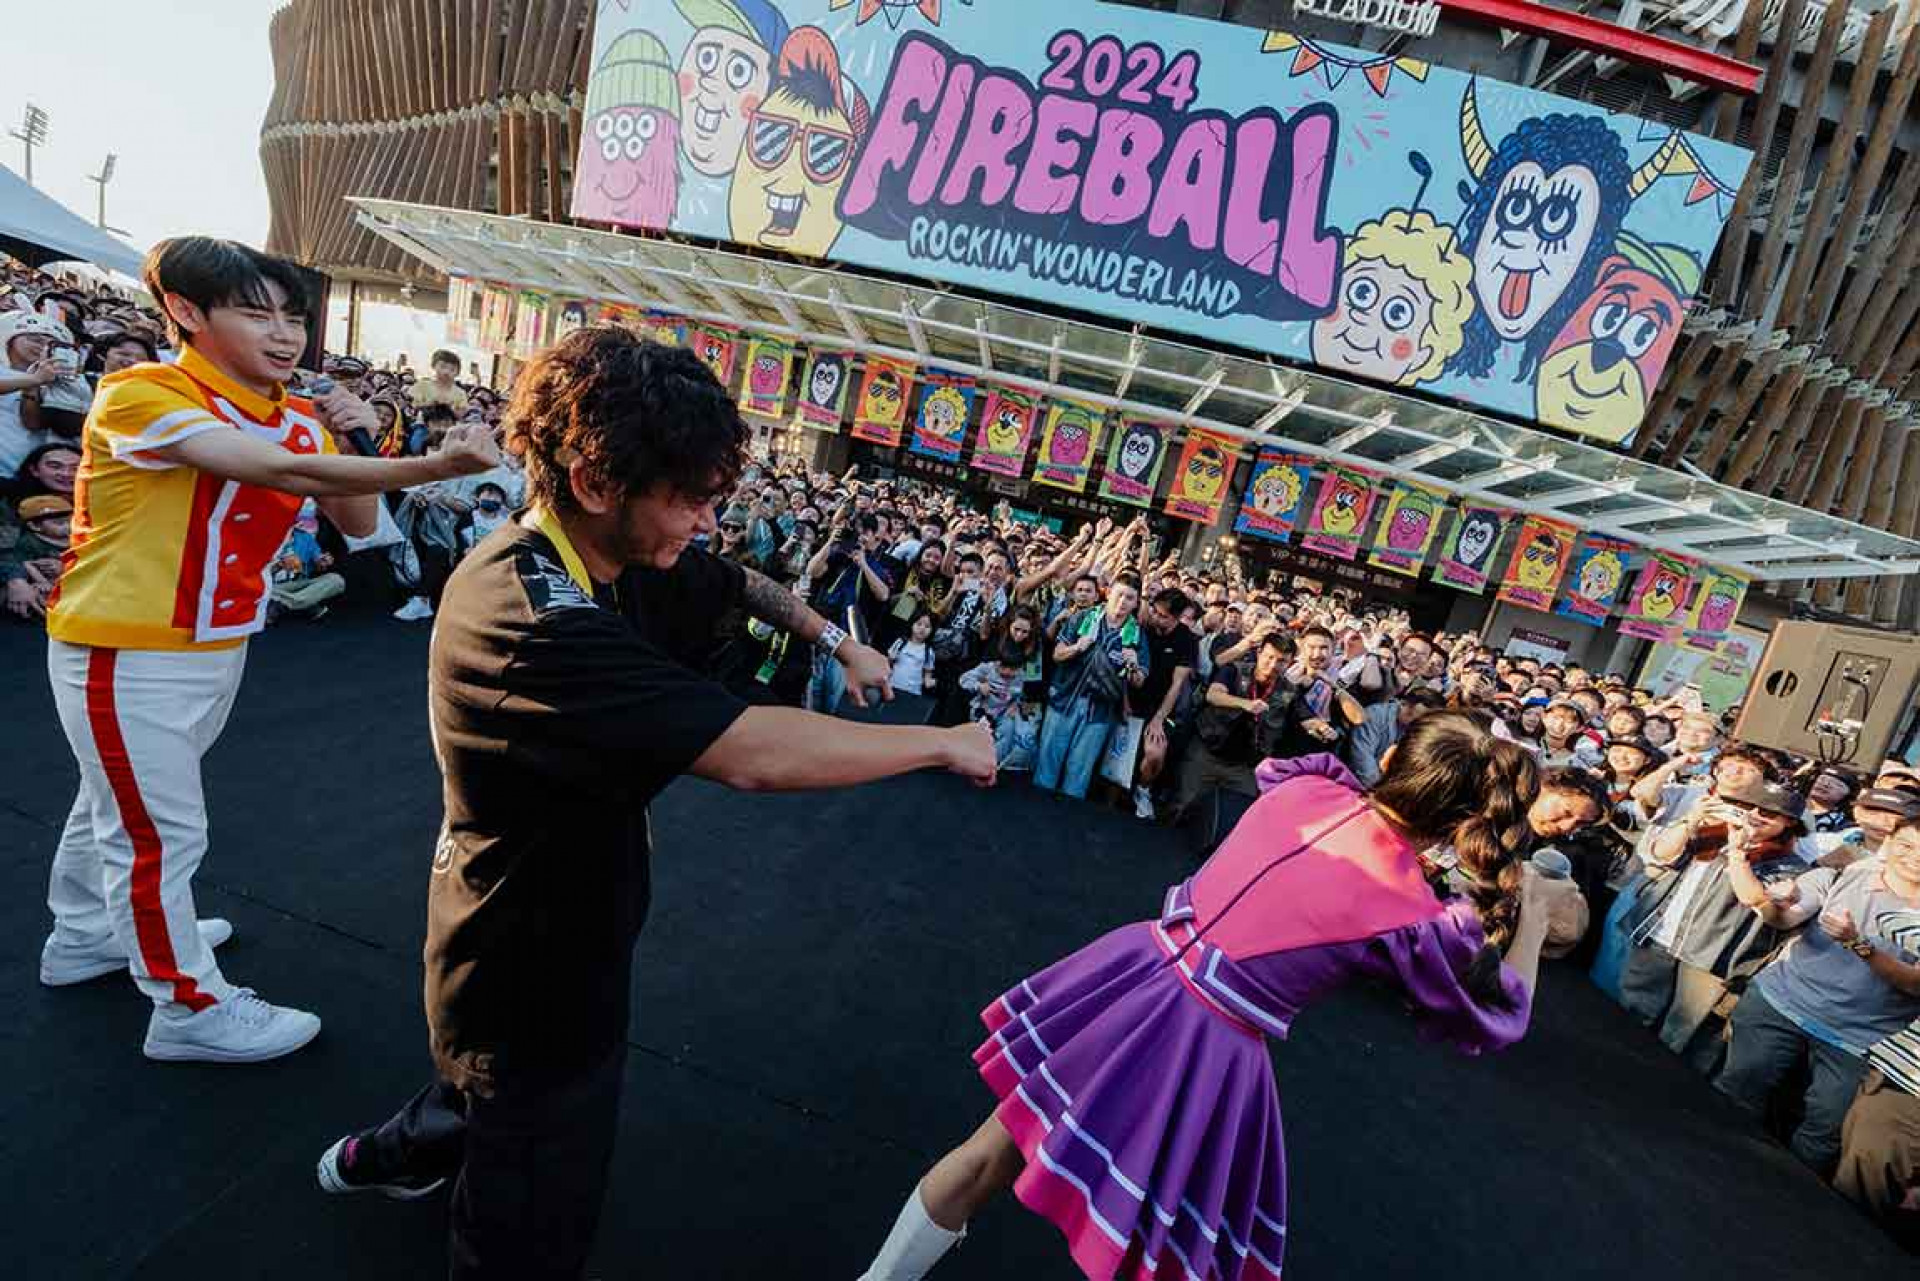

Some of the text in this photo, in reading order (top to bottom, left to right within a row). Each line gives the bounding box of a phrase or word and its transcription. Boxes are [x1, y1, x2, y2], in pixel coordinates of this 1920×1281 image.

[1043, 33, 1196, 110] 2024
[841, 38, 1339, 308] FIREBALL
[1031, 239, 1241, 313] WONDERLAND
